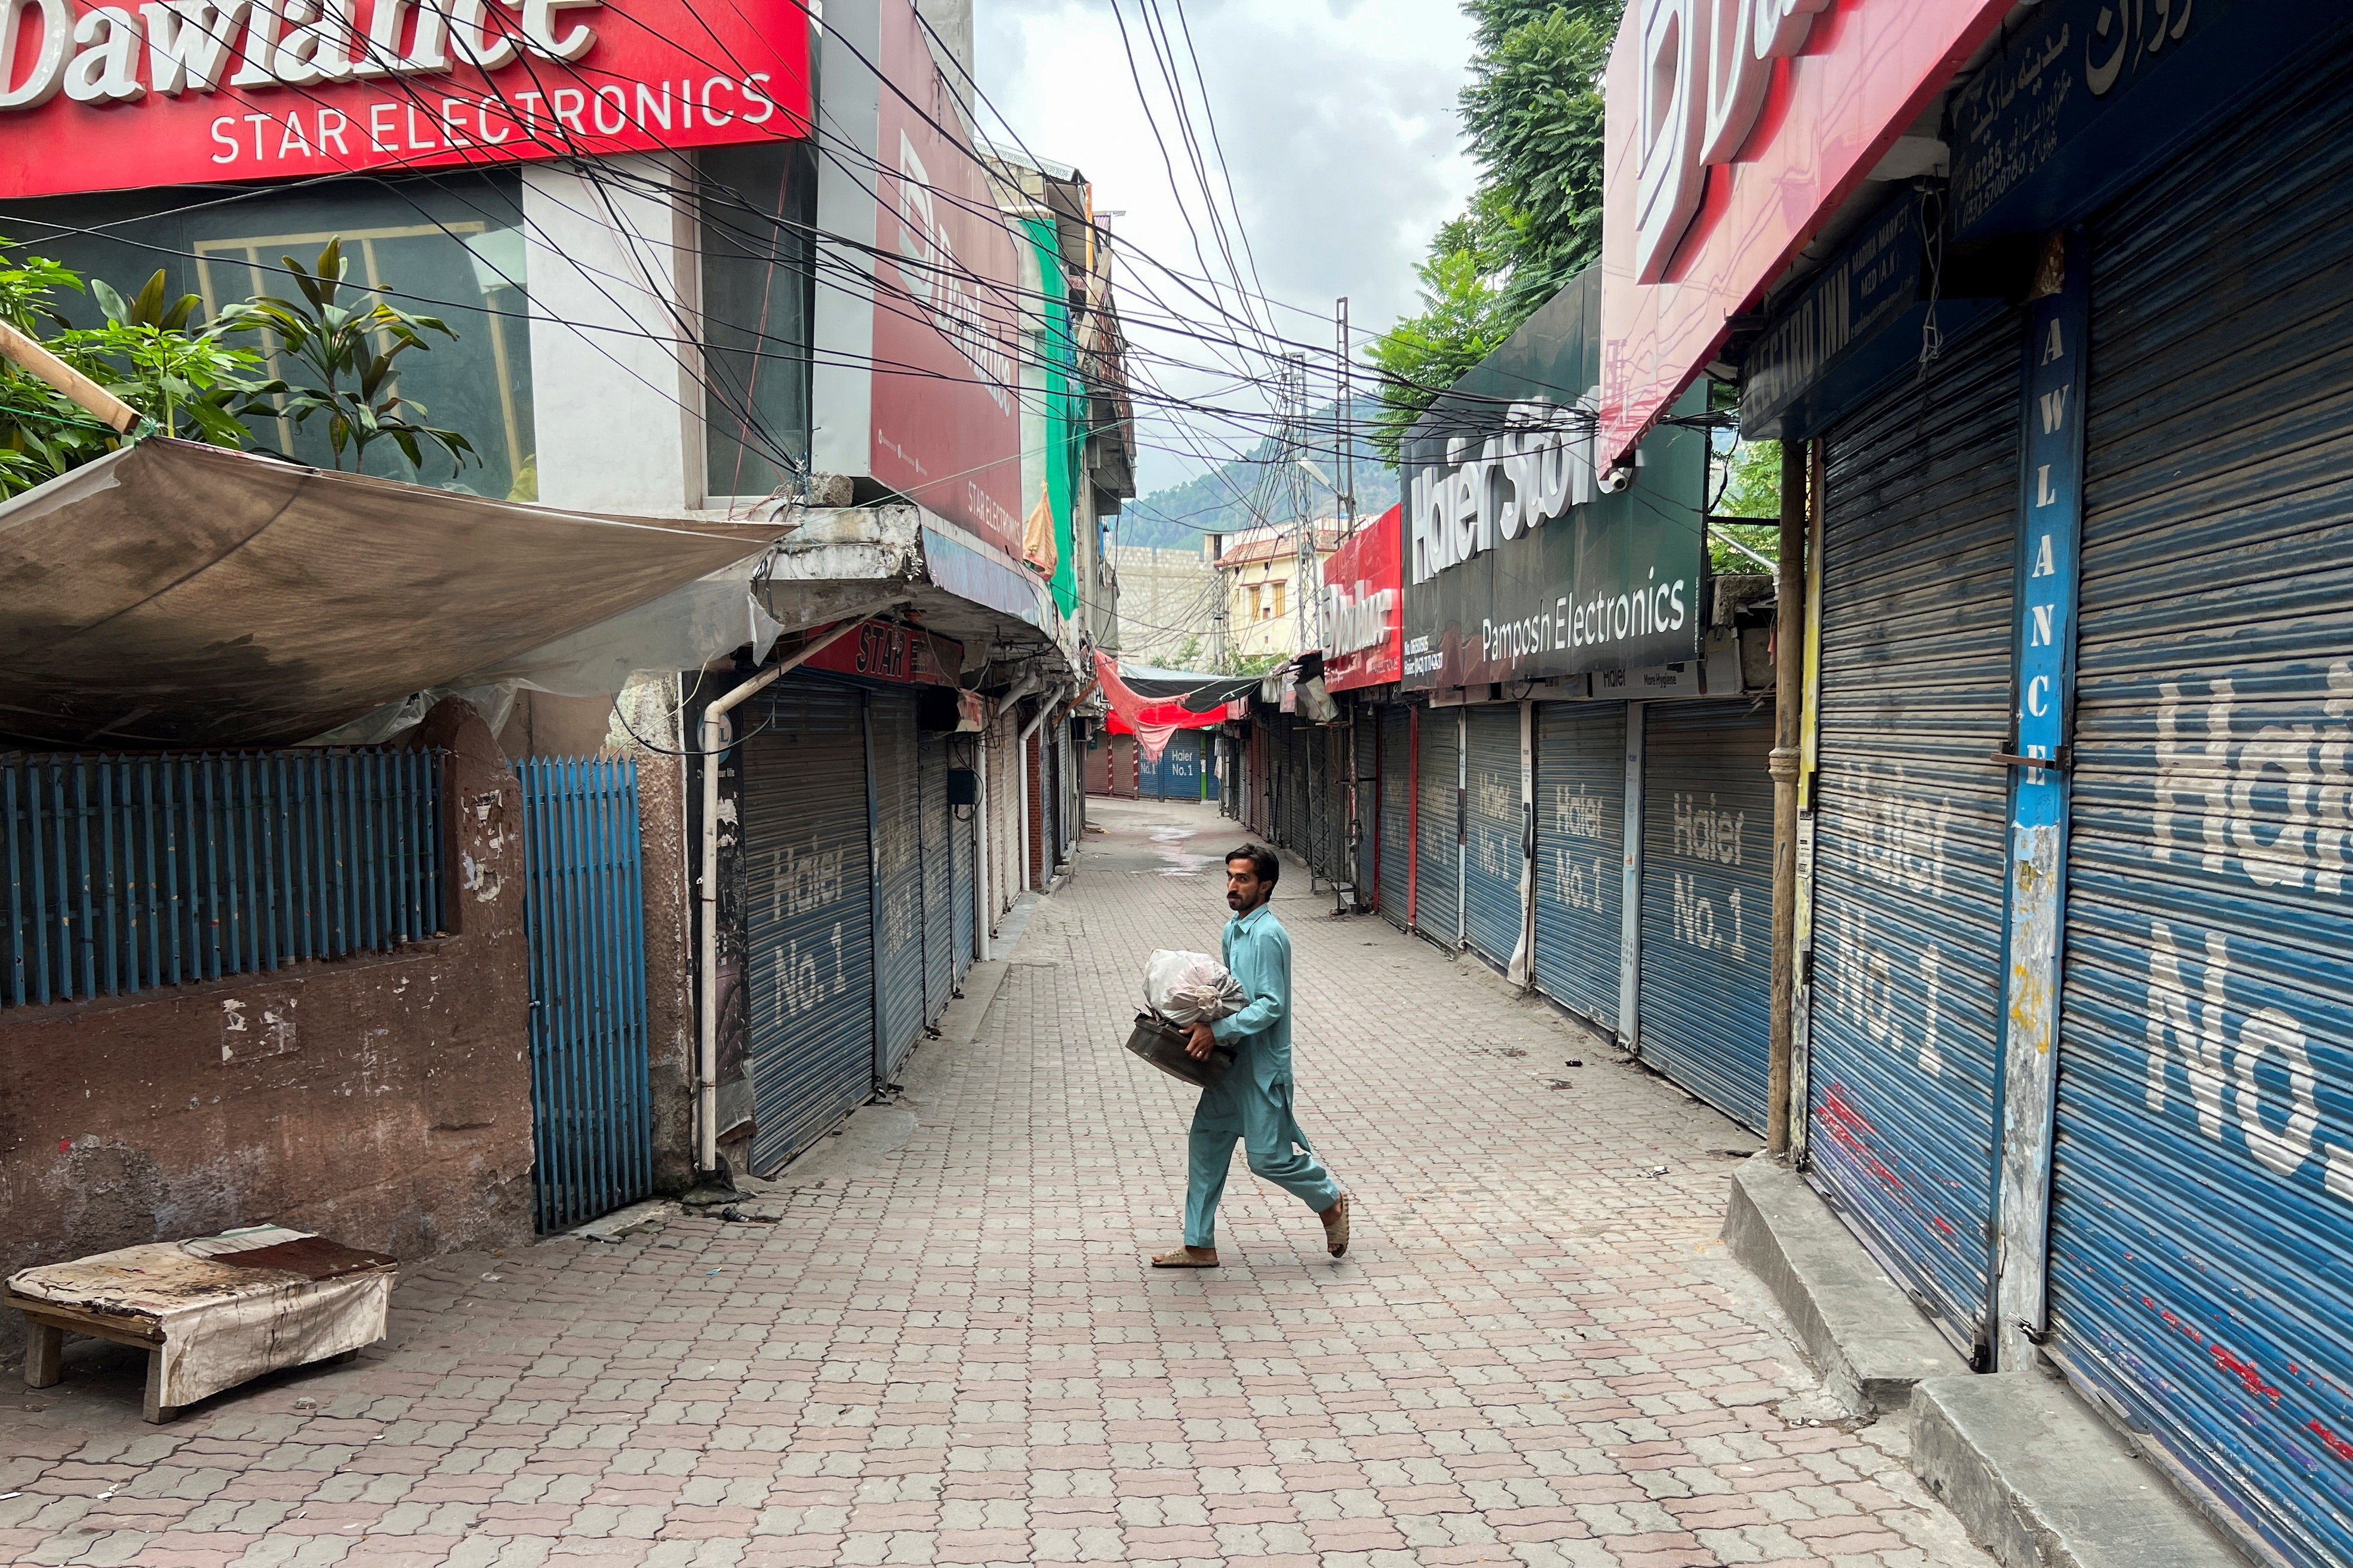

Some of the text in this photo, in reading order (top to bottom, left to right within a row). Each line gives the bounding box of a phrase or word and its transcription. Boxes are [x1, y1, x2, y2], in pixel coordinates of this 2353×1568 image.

[210, 72, 775, 164] STAR ELECTRONICS
[936, 222, 1011, 417] Dawlance
[1818, 261, 1850, 365] INN
[1860, 272, 1877, 300] MZD
[968, 480, 1021, 547] STAR ELECTRONICS
[1411, 385, 1634, 585] Haier Stor
[856, 622, 905, 677] STAR
[1482, 599, 1551, 670] Pamposh
[1555, 566, 1685, 651] Electronics
[1644, 673, 1656, 686] More
[1172, 750, 1193, 762] Haier
[1480, 772, 1510, 821] Haier
[1557, 783, 1602, 838] Haier
[1674, 793, 1744, 865] Haier
[1840, 762, 1952, 897] Haier
[774, 836, 842, 921] Haier
